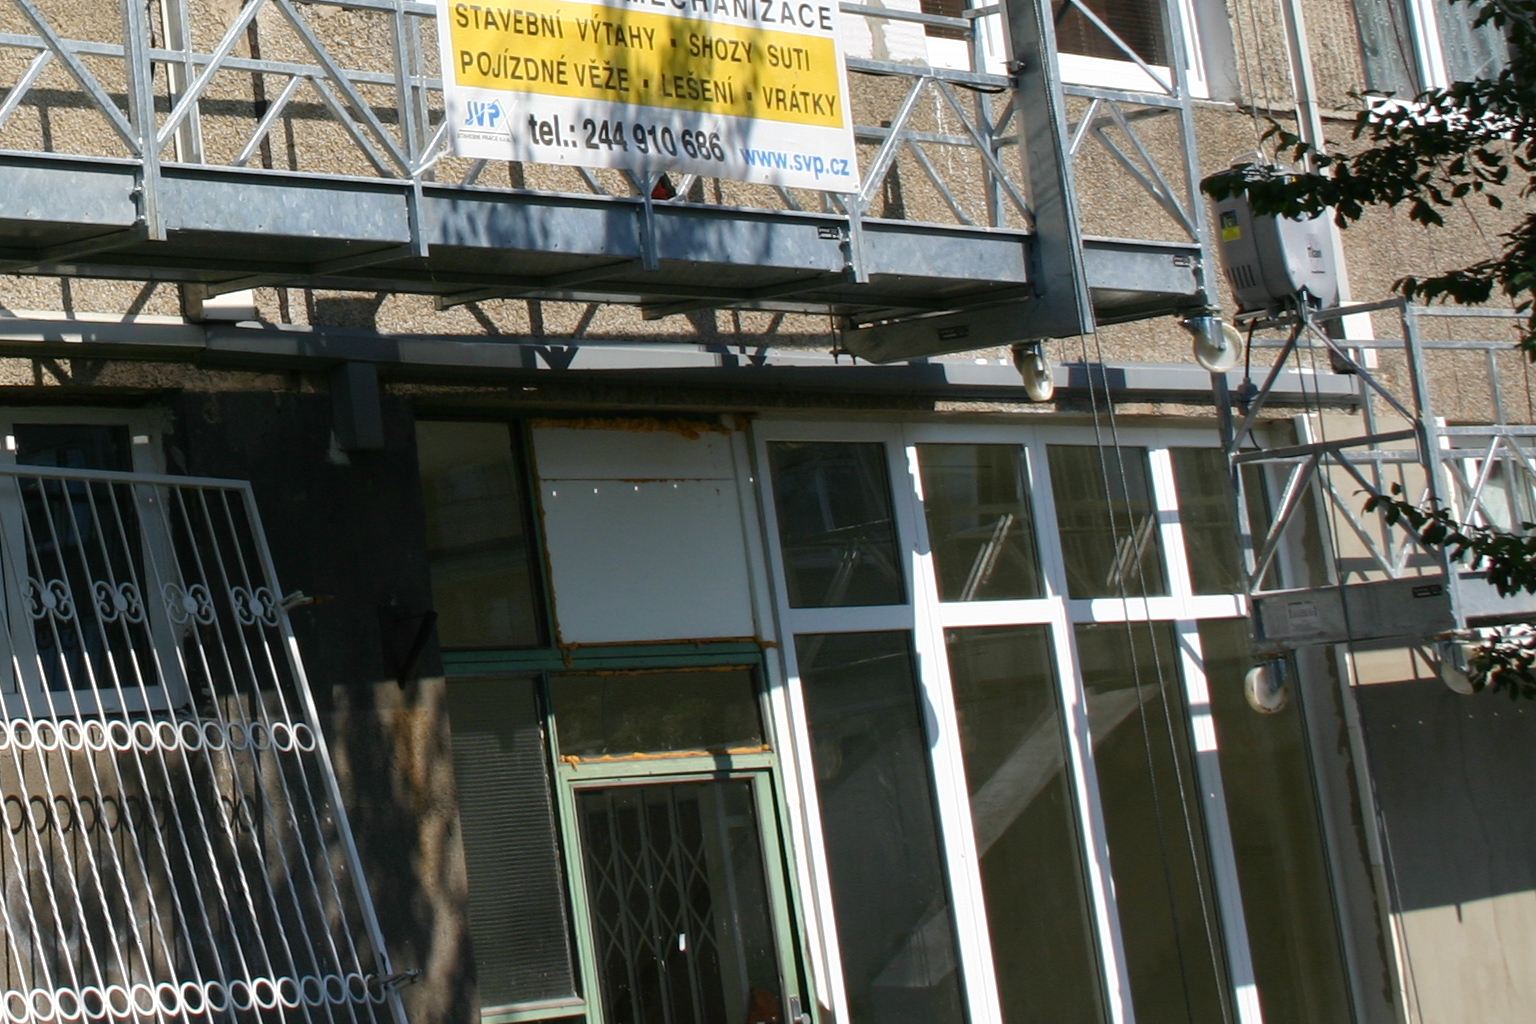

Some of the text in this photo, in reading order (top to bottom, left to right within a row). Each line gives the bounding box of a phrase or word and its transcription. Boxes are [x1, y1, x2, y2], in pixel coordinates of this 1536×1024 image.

[455, 3, 810, 71] STAVEBNÍ VÝTAHY SHOZY SUTI
[460, 48, 836, 116] POJÍZDNÉ VĚŽE LEŠENÍ VRÁTKY
[528, 113, 725, 163] tel.: 244 910 686
[739, 148, 850, 180] www.svp.cz
